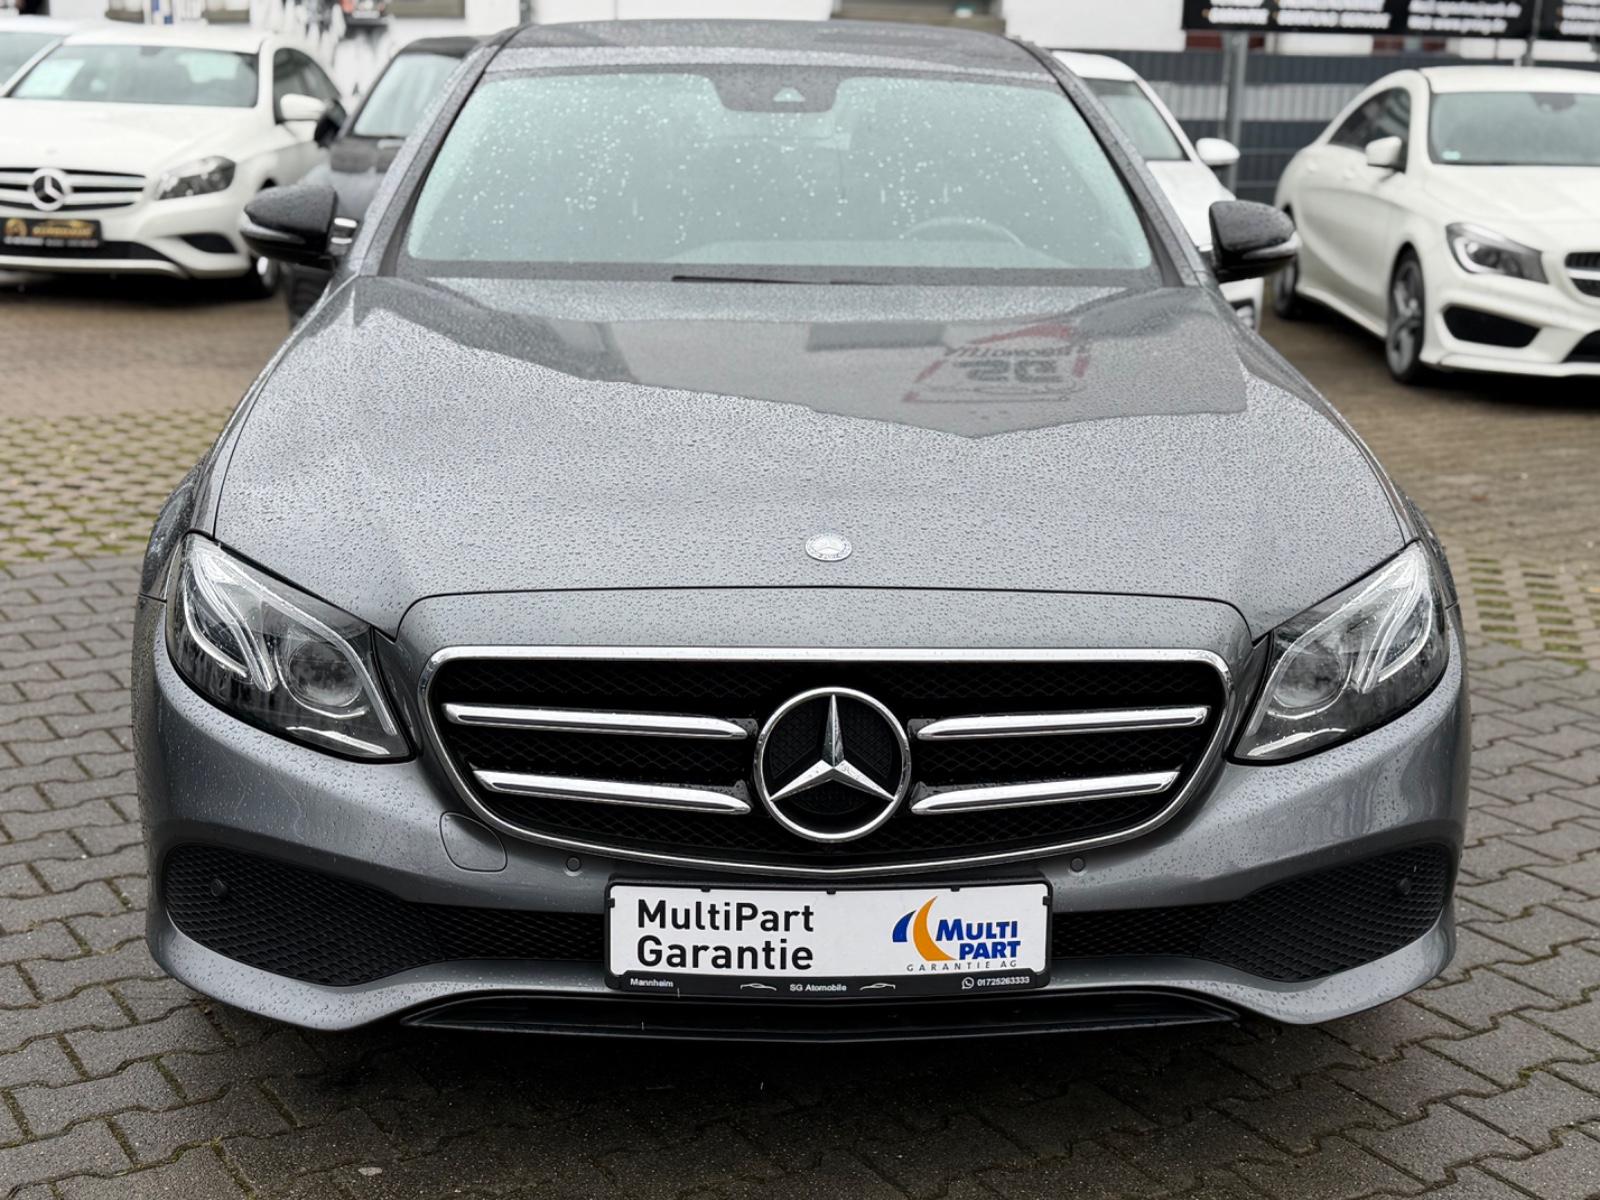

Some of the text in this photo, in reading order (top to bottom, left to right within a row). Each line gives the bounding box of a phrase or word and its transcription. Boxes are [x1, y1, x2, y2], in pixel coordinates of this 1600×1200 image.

[637, 898, 814, 932] MultiPart
[637, 934, 813, 970] Garantie
[958, 940, 1021, 960] PART
[906, 960, 1017, 972] GARANTIE AG
[630, 977, 673, 988] Mannheim
[790, 983, 847, 992] SG Atomobile
[976, 976, 1030, 987] 01725263333
